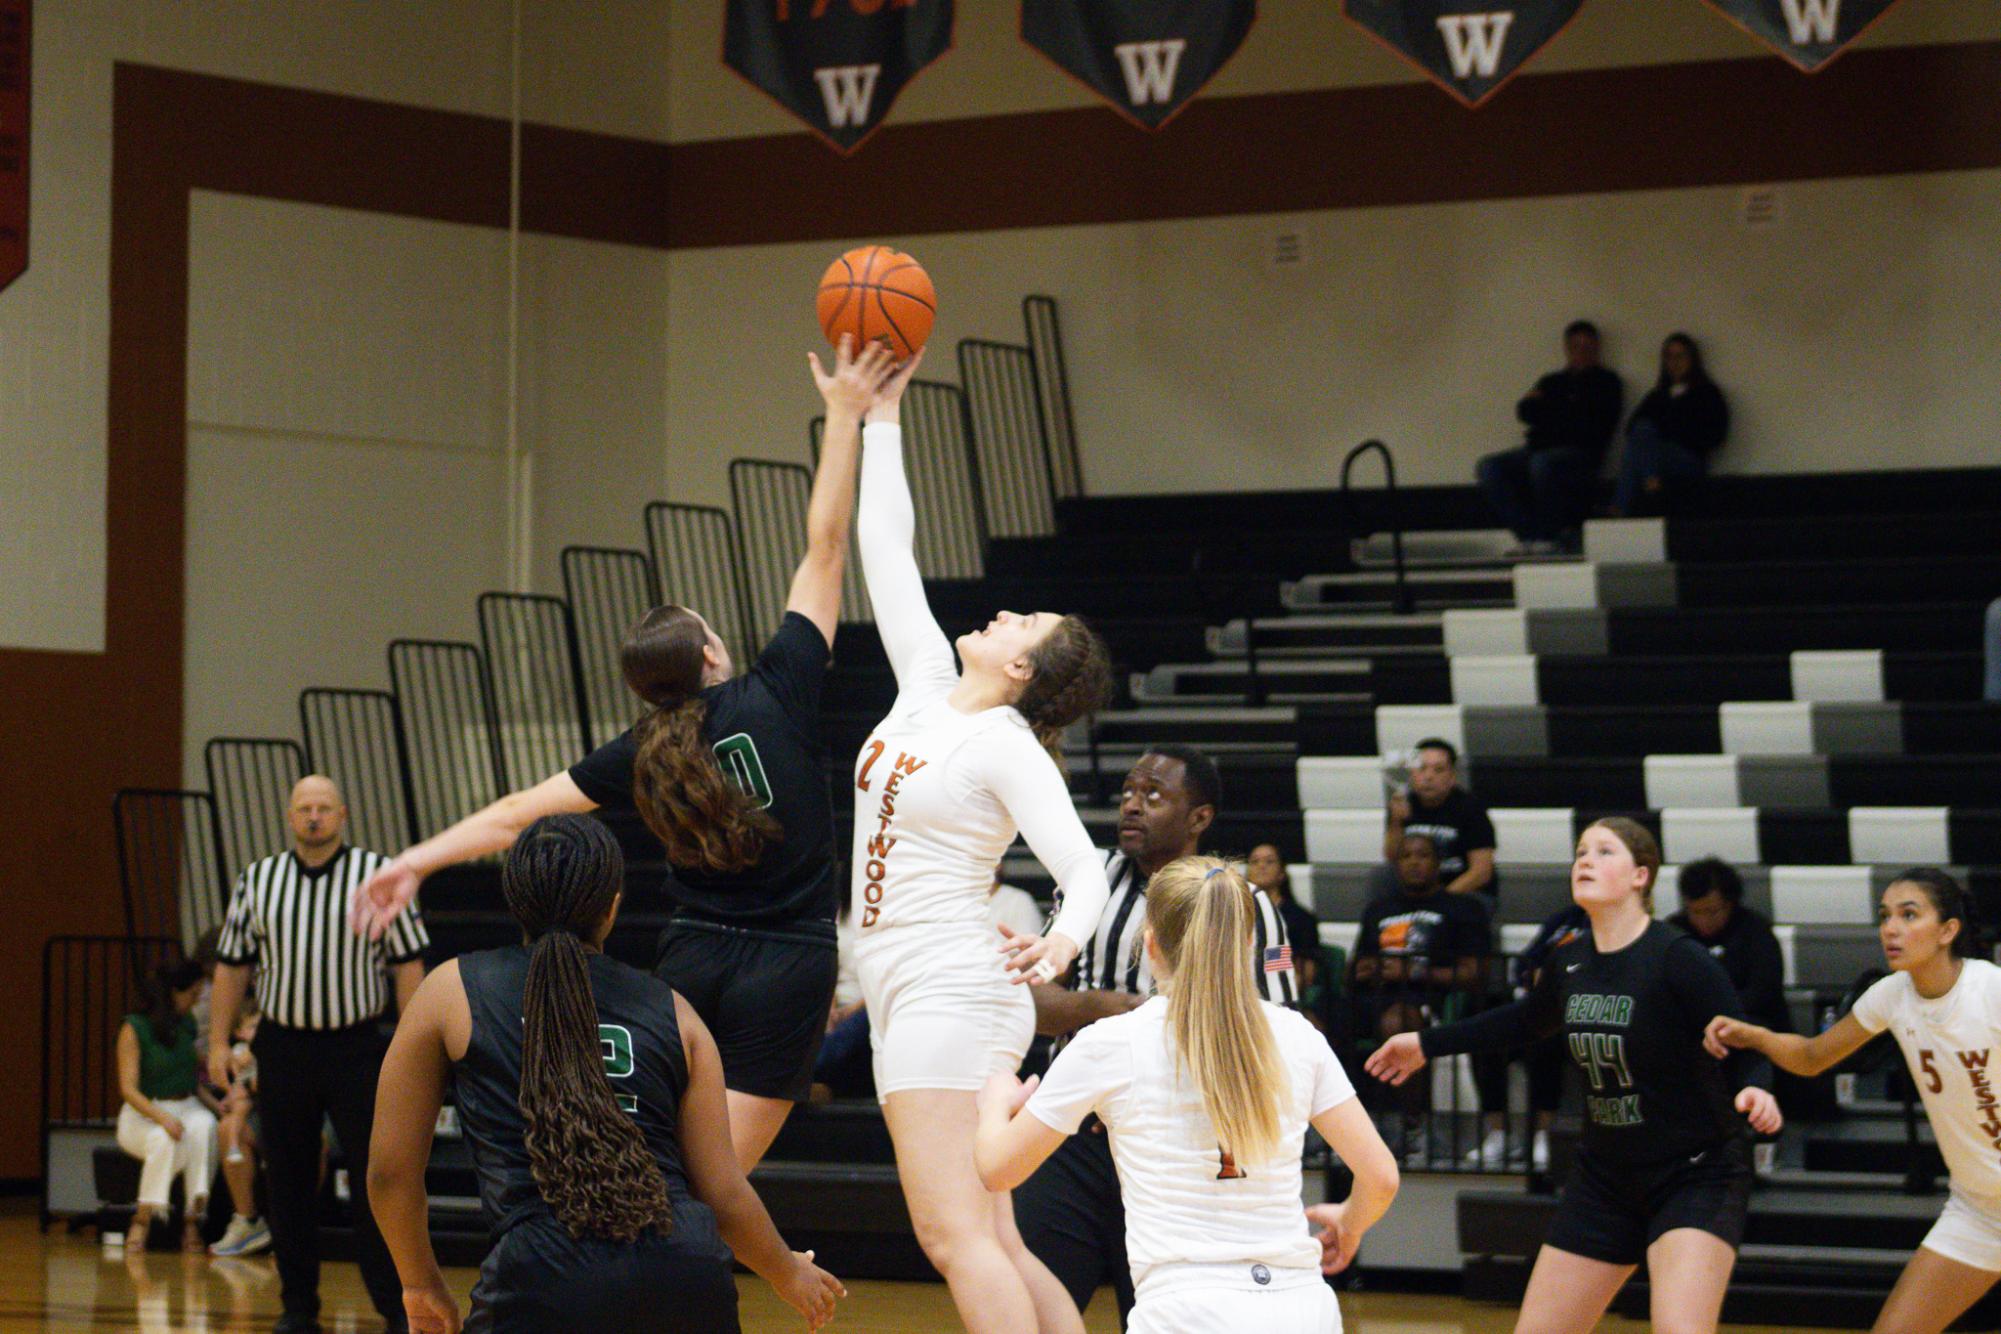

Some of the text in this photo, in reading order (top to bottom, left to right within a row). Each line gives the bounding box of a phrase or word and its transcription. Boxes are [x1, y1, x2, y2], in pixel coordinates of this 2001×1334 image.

[1436, 10, 1514, 78] W
[1779, 0, 1840, 44] W
[813, 64, 881, 127] W
[1113, 38, 1187, 106] W
[861, 751, 928, 928] WESTWOOD
[1565, 994, 1634, 1027] CEDAR
[1568, 1032, 1633, 1089] 44
[1919, 1049, 1943, 1094] 5
